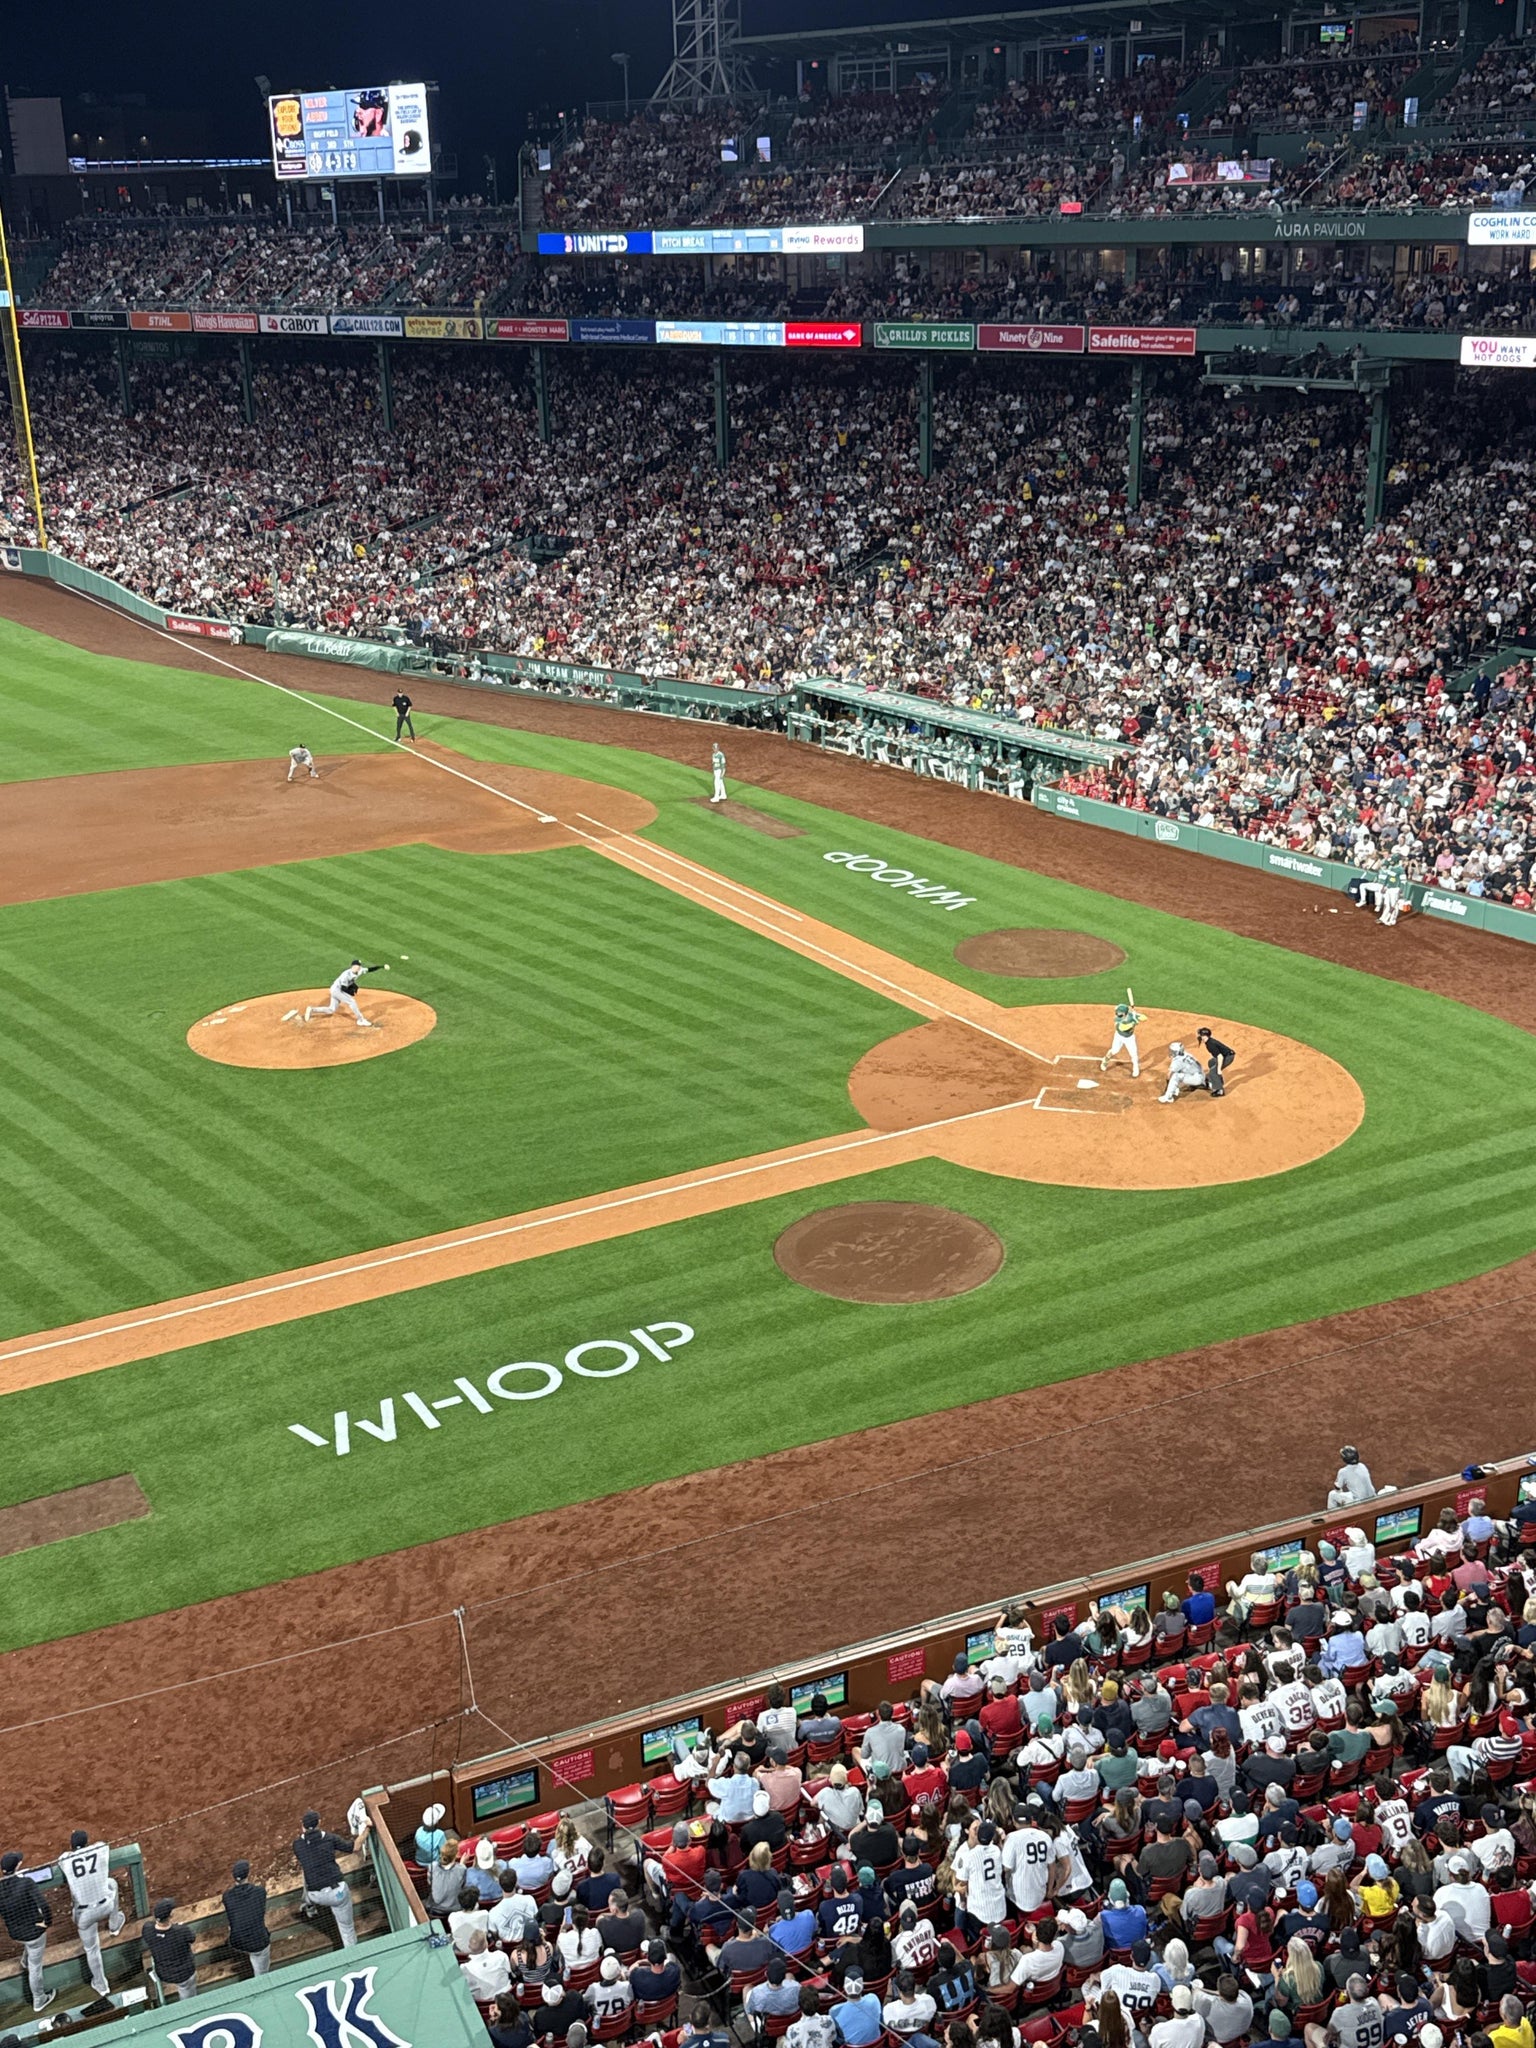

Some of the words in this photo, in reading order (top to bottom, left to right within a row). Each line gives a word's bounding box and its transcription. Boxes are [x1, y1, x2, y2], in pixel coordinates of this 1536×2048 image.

[1313, 222, 1366, 237] PAVILION
[1473, 217, 1521, 227] COGHLIN
[814, 234, 859, 245] Rewards
[1489, 229, 1510, 240] WORK
[578, 235, 628, 253] UNITED
[39, 315, 63, 326] PIZZA
[148, 316, 173, 327] STIHL
[788, 332, 805, 340] BANK
[814, 332, 843, 340] AMERICA
[889, 330, 928, 341] GRILLO'S
[931, 331, 970, 342] PICKLES
[999, 332, 1028, 345] Ninety
[1043, 332, 1064, 343] Nine
[1091, 333, 1140, 349] Safelite
[1471, 340, 1498, 353] YOU
[1500, 346, 1528, 354] WANT
[1474, 354, 1492, 362] HOT
[1496, 354, 1522, 363] DOGS
[1269, 854, 1323, 878] smartwater
[822, 851, 977, 911] WHOOP
[286, 1321, 695, 1457] WHOOP
[1415, 1627, 1426, 1645] 2
[889, 1649, 925, 1664] CAUTION!
[1009, 1643, 1026, 1657] 29
[1289, 1701, 1313, 1724] 35
[1328, 1699, 1342, 1718] 11
[553, 1751, 592, 1767] CAUTION!
[1393, 1817, 1408, 1839] 9
[1026, 1840, 1048, 1864] 99
[71, 1853, 98, 1878] 67
[564, 1854, 587, 1874] 34
[983, 1857, 996, 1881] 2
[1288, 1869, 1302, 1887] 2
[836, 1903, 856, 1916] RIZZO
[832, 1913, 859, 1935] 48
[902, 1930, 931, 1954] ANTHONY
[597, 1997, 625, 2017] 78
[1122, 1993, 1154, 2011] 99
[1406, 2010, 1428, 2030] JETER
[1355, 2022, 1382, 2048] 99
